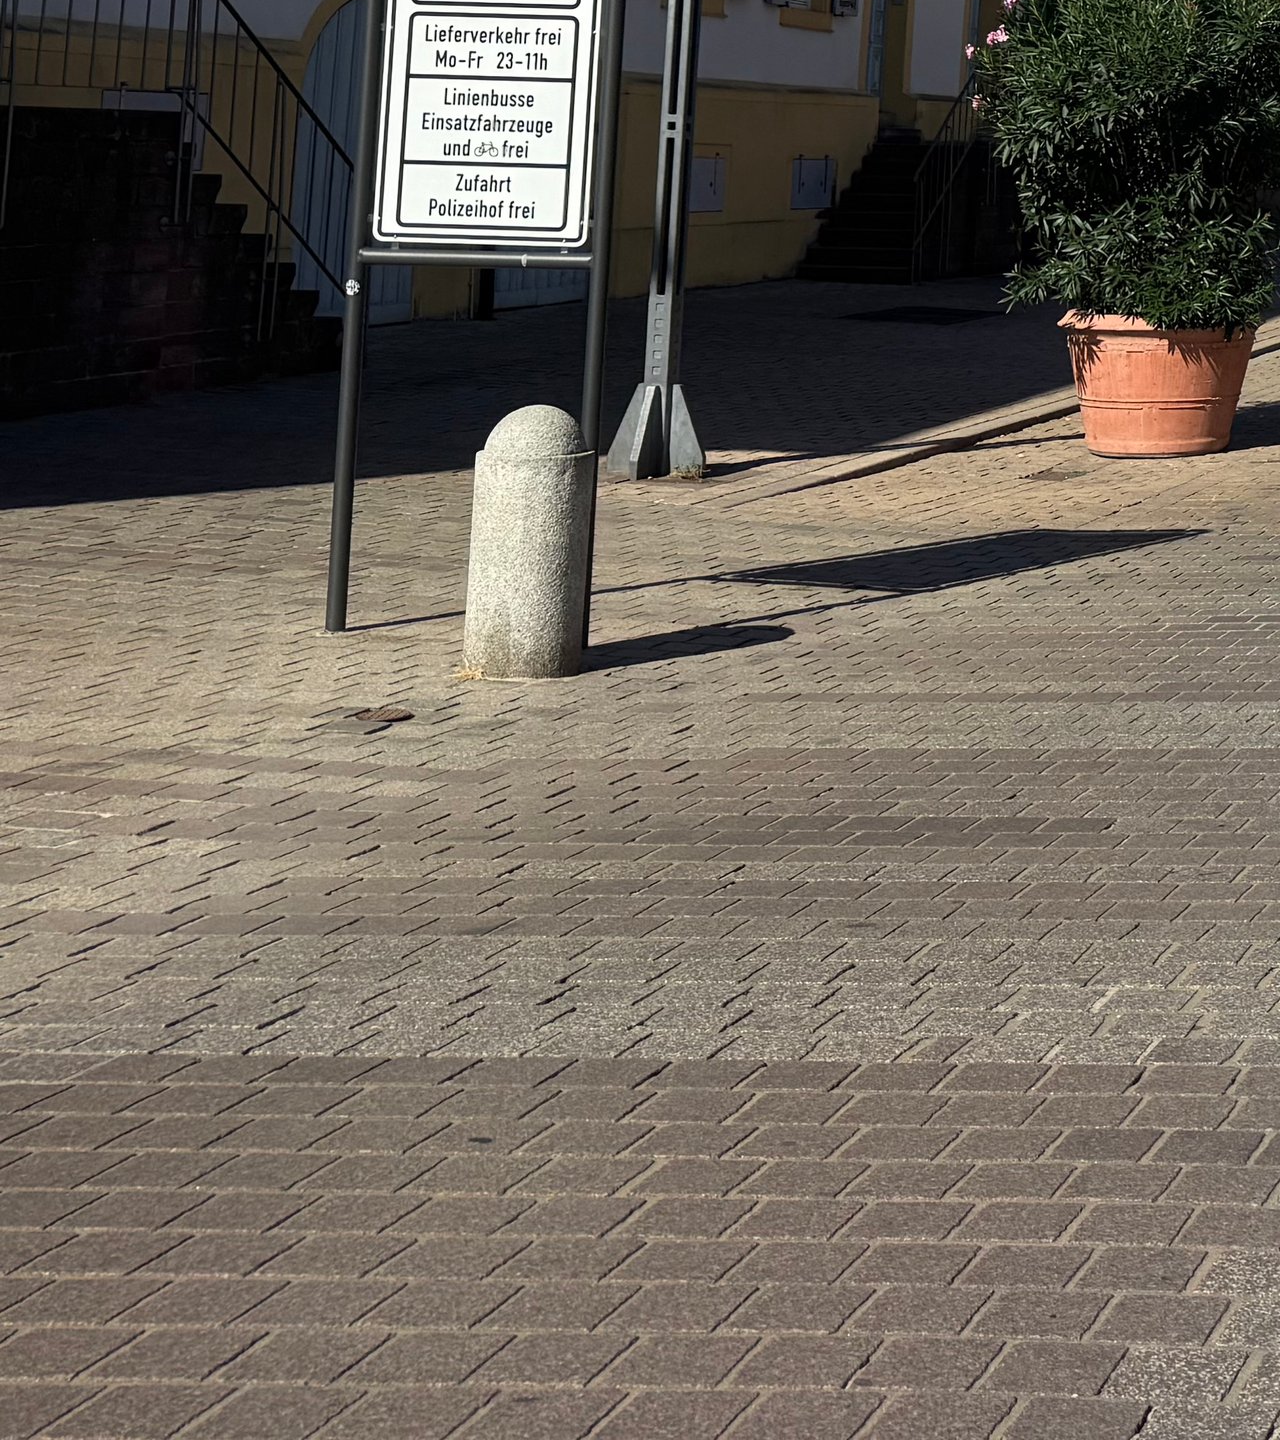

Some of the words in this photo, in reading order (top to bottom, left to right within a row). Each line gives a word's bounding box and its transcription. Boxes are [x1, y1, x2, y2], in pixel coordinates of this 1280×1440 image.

[425, 25, 530, 45] Lieferverkehr
[535, 27, 562, 46] frei
[435, 50, 484, 69] Mo-Fr
[496, 51, 548, 72] 23-11h
[444, 88, 535, 108] Linienbusse
[421, 112, 553, 137] Einsatzfahrzeuge
[443, 139, 471, 157] und
[502, 140, 529, 159] frei
[455, 173, 511, 193] Zufahrt
[429, 198, 504, 218] Polizeihof
[508, 201, 536, 219] frei
